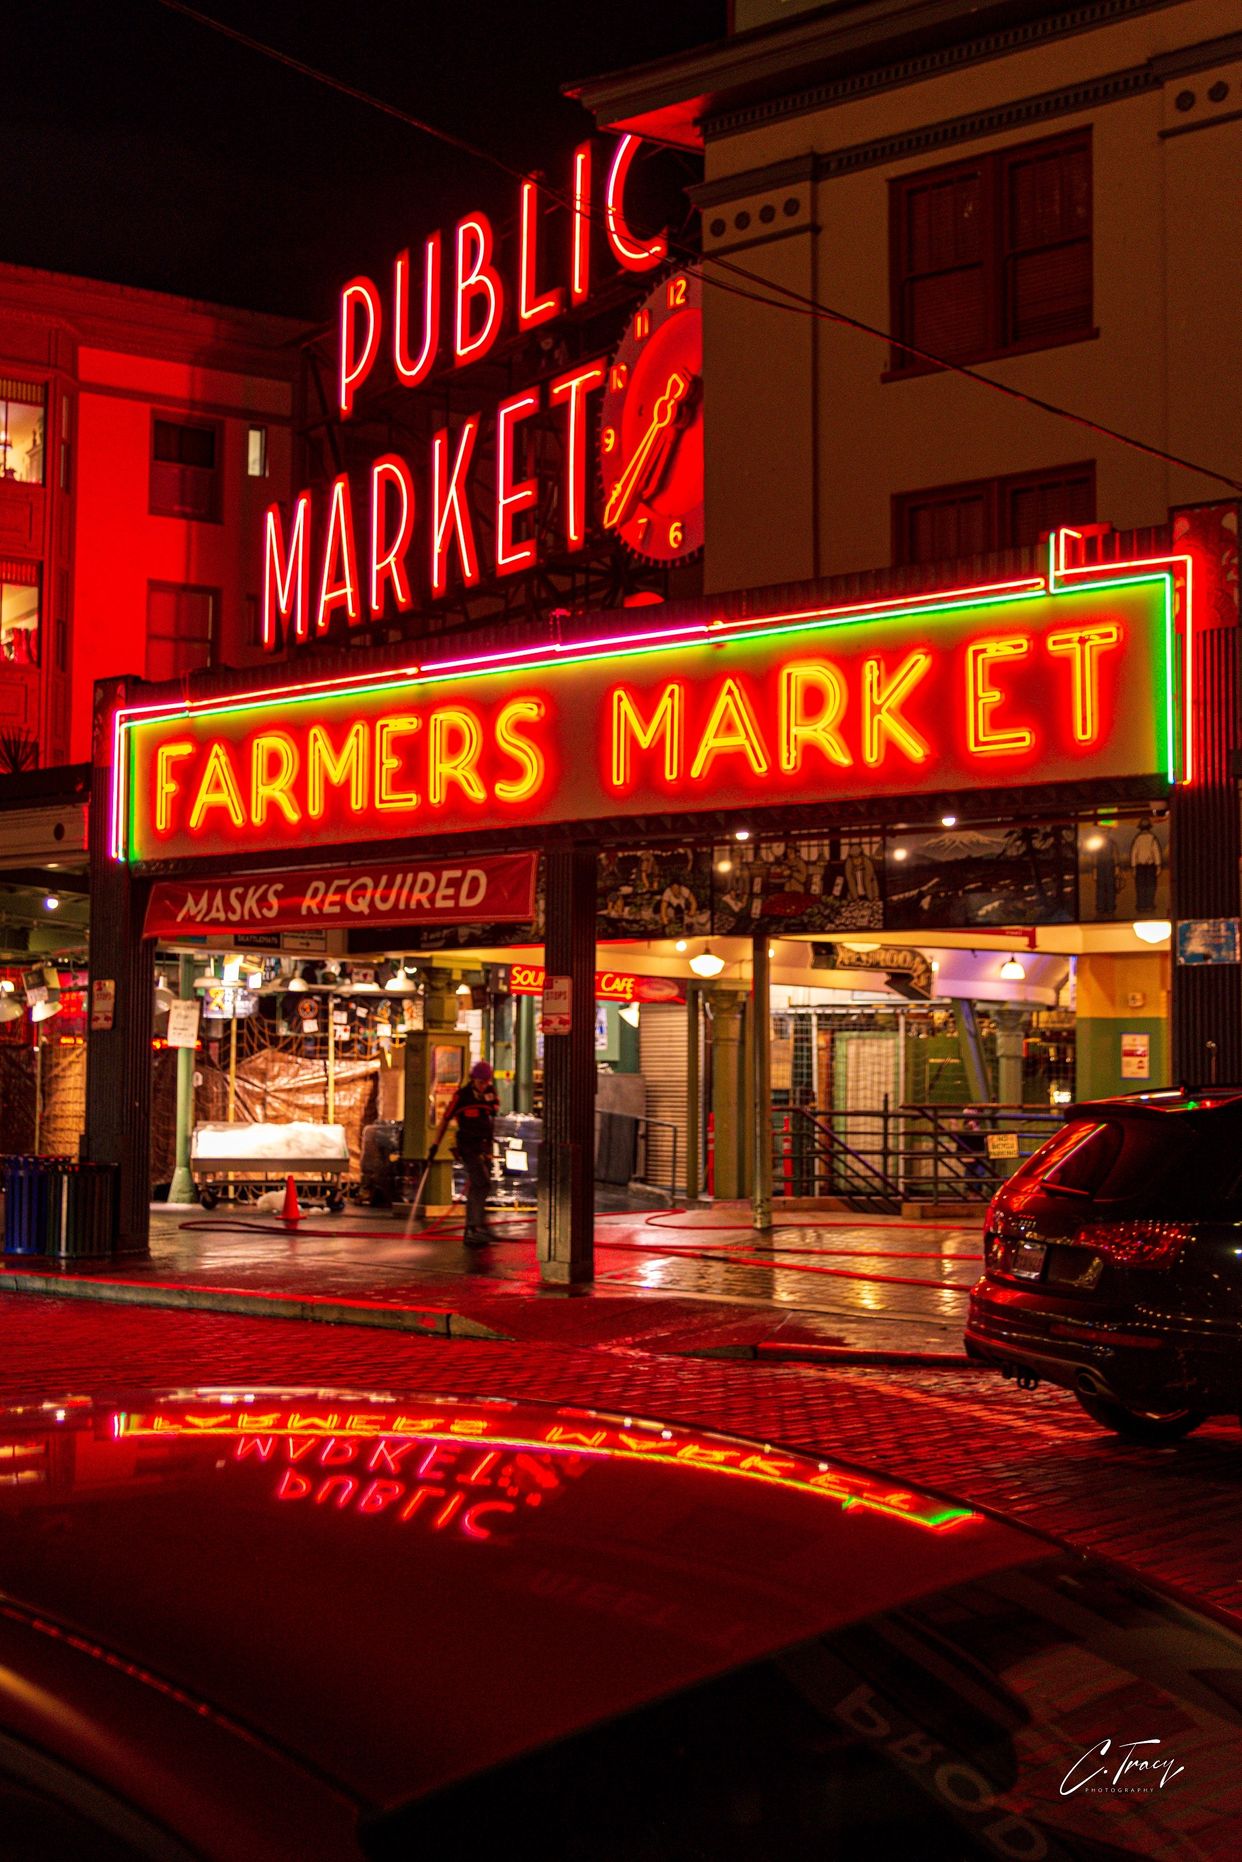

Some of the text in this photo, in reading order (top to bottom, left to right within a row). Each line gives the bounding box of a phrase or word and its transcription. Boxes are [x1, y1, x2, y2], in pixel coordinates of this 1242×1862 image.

[338, 133, 669, 419] PUBLIC
[667, 277, 687, 307] 12
[603, 428, 615, 453] 9
[262, 357, 609, 652] MARKET
[668, 520, 684, 549] 6
[154, 624, 1124, 833] FARMERS MARKET
[176, 868, 488, 923] MASKS REQUIRED
